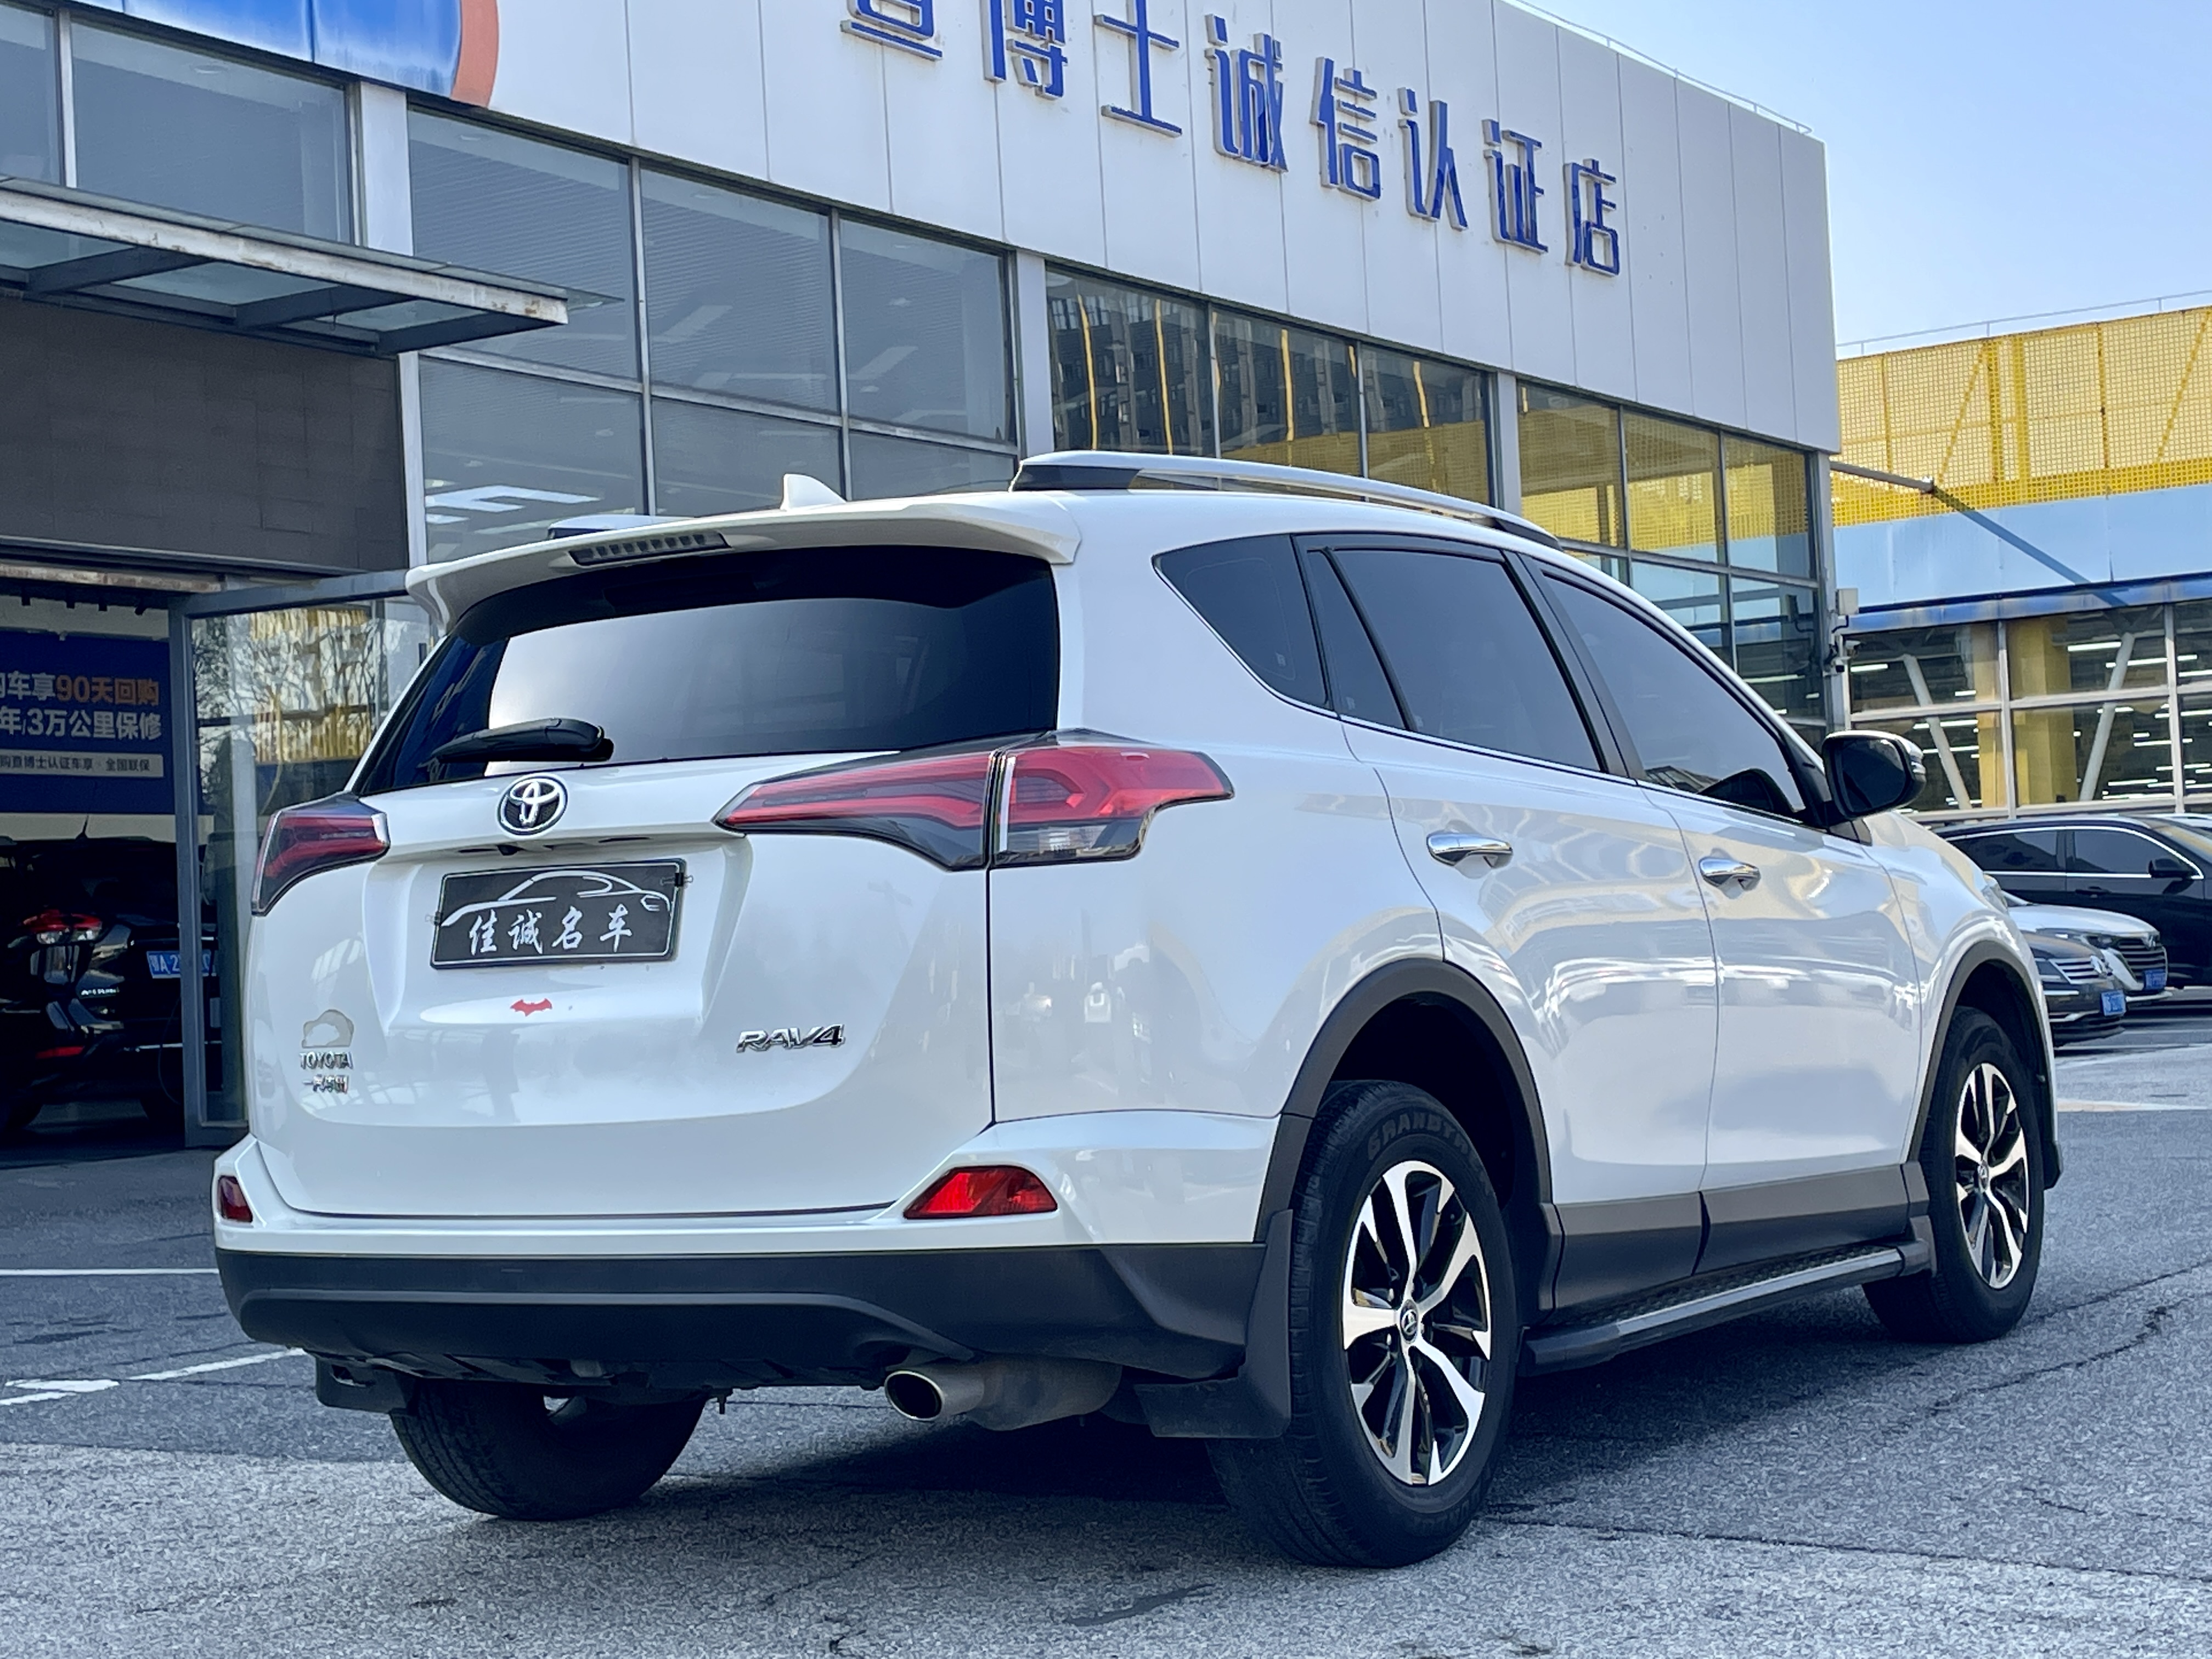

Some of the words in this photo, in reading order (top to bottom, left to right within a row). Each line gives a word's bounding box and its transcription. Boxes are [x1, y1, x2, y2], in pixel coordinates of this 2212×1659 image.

[468, 903, 633, 956] 佳诚名车
[736, 1023, 845, 1054] RAV4
[298, 1051, 354, 1070] TOYOTA
